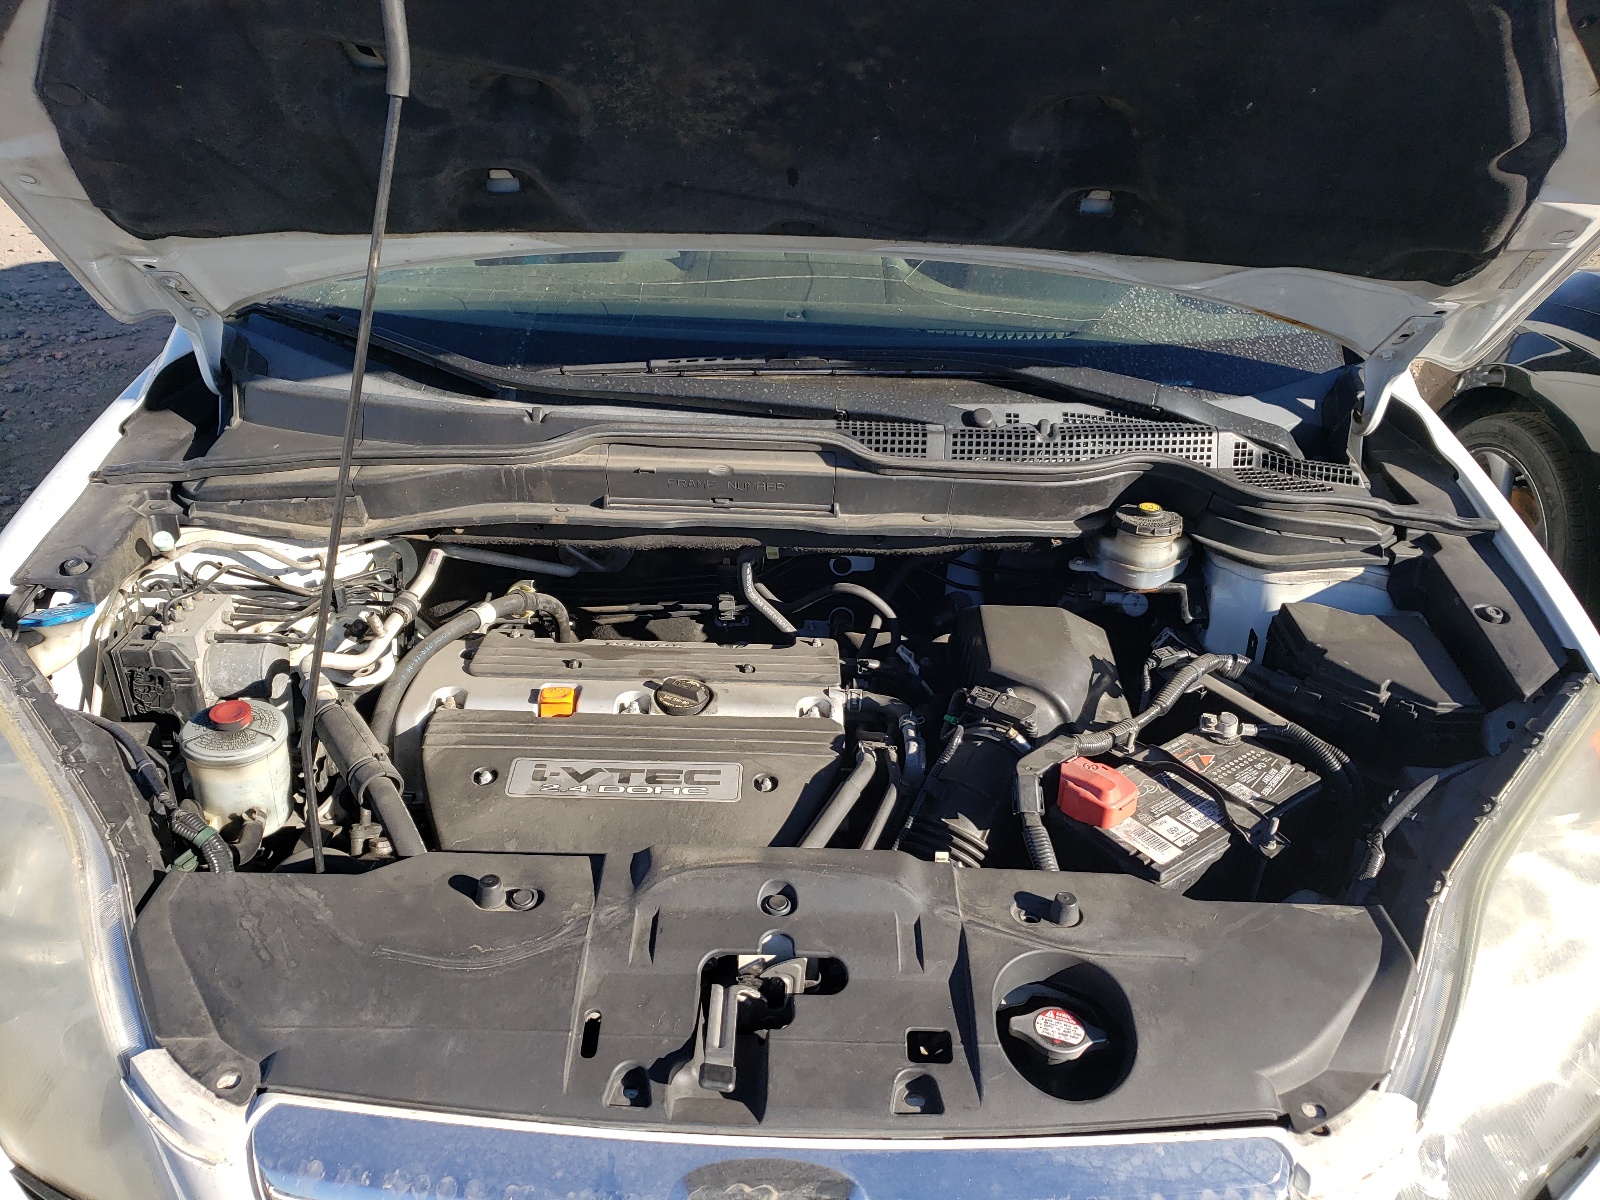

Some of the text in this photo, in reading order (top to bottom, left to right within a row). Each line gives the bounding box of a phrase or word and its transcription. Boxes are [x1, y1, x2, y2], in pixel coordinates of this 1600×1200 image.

[667, 478, 786, 492] FRAME NUMBER
[531, 763, 722, 786] i-VTEC
[539, 783, 709, 796] 2.4 DOHC
